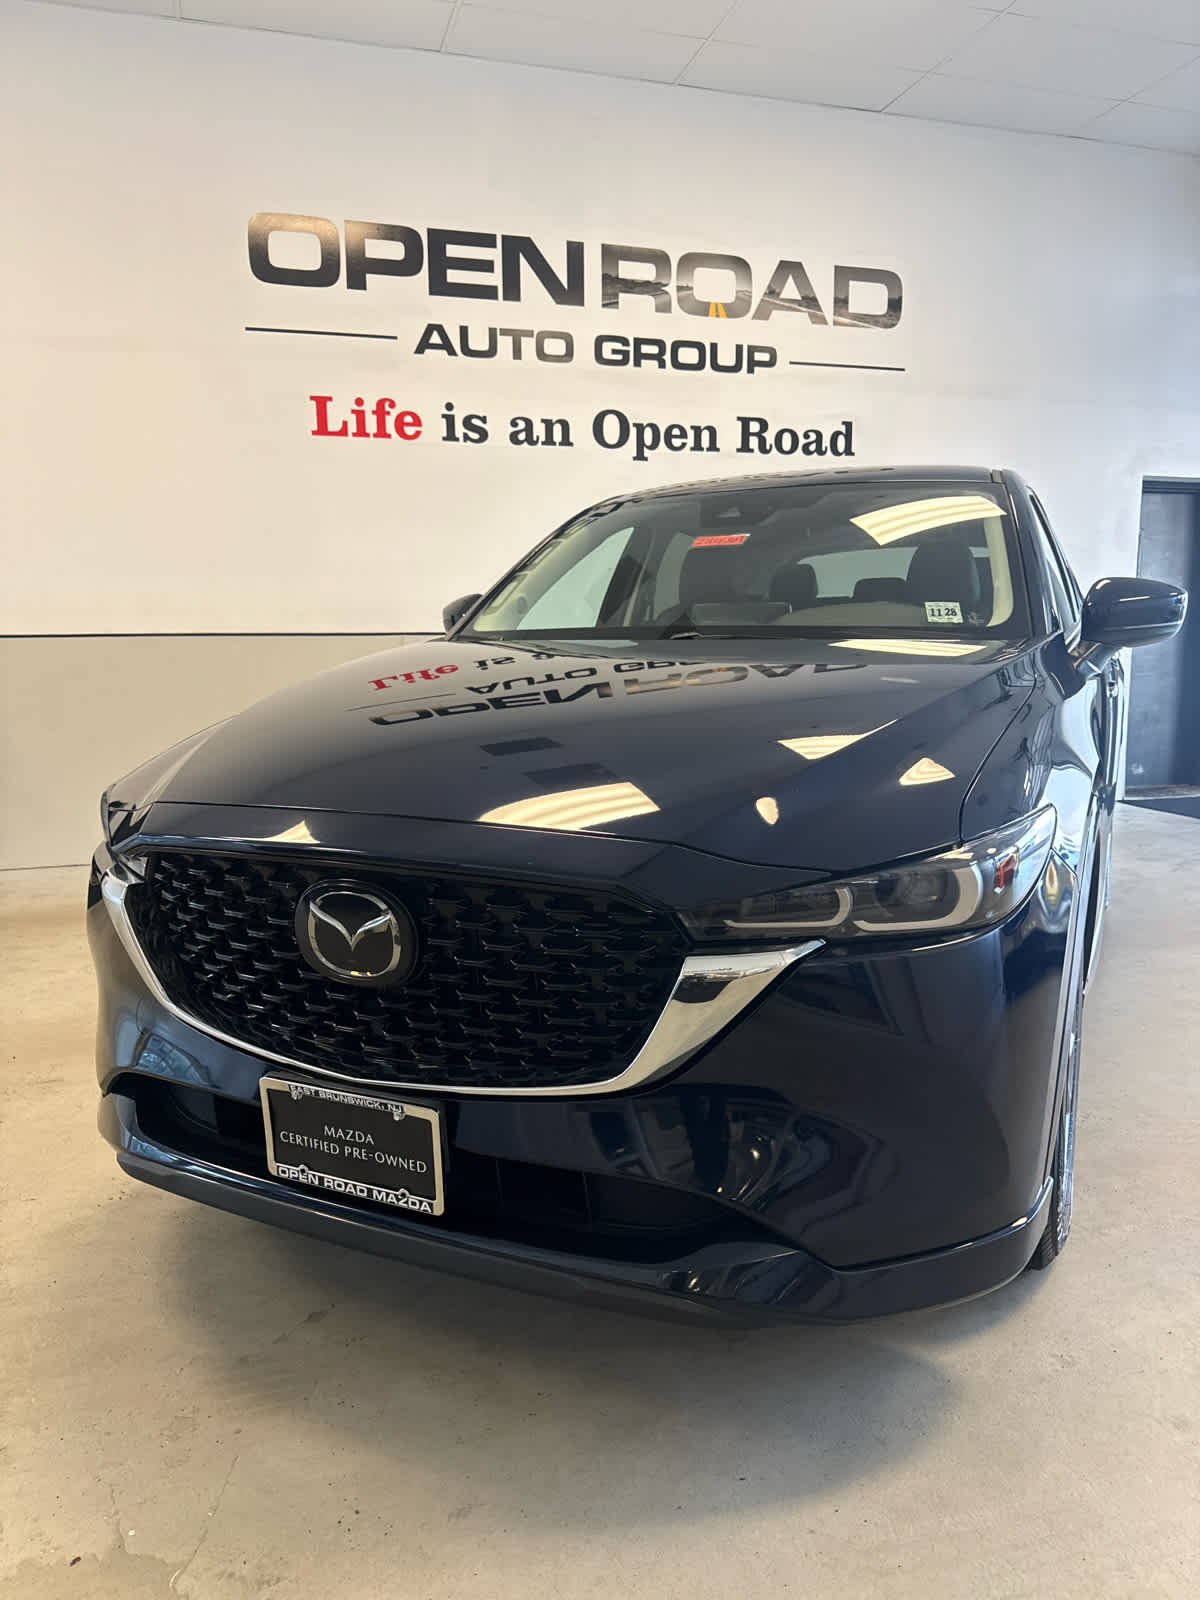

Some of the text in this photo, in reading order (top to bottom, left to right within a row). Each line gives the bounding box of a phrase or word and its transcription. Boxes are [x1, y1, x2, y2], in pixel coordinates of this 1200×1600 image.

[248, 212, 904, 330] OPEN ROAD
[414, 323, 777, 375] AUTO GROUP
[310, 395, 855, 461] Life is an Open Road
[319, 1090, 386, 1110] BRUNSWICK,
[388, 1104, 402, 1113] NJ
[280, 1131, 428, 1174] CERTIFIED PRE-OWNED
[324, 1124, 375, 1145] MAZDA
[278, 1167, 433, 1214] OPEN ROAD MAZDA
